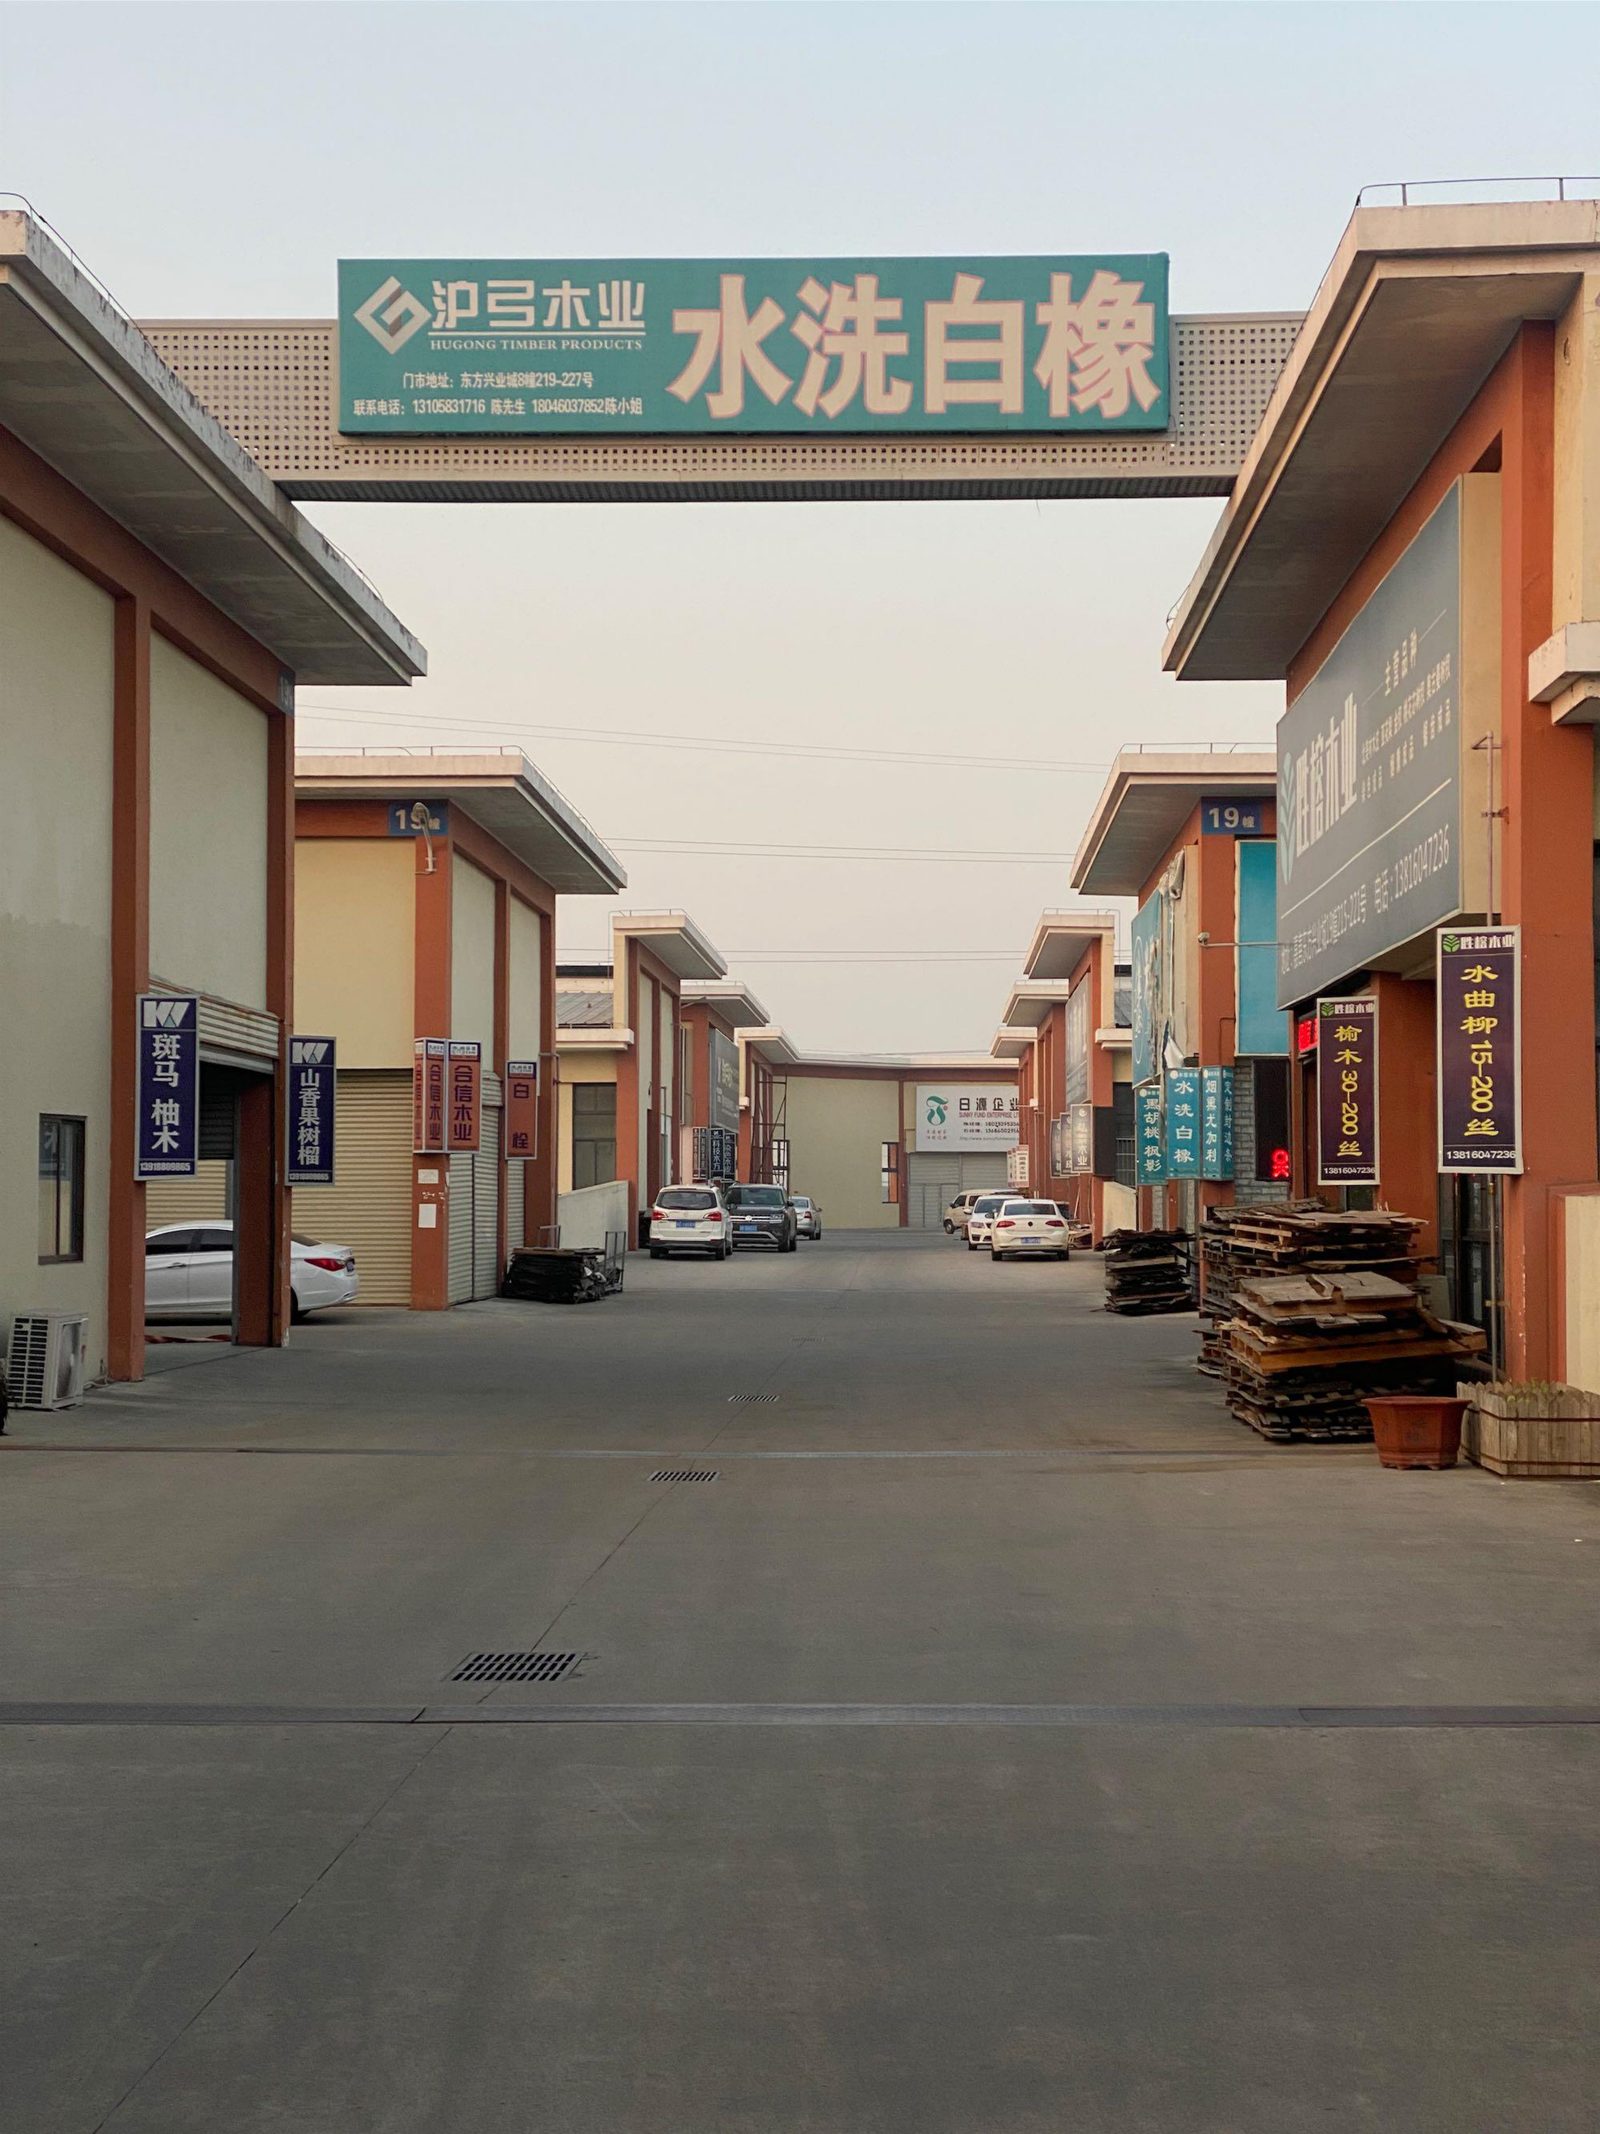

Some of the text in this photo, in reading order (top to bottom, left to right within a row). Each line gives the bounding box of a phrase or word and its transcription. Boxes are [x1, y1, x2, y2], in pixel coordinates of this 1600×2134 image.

[432, 280, 645, 329] 沪弓木业
[430, 339, 642, 350] HUGONG TIMBER PRODUCTS
[664, 270, 1162, 420] 水洗白橡
[413, 398, 486, 415] 13105831716
[297, 1068, 321, 1166] 山香果树榴
[453, 1065, 473, 1141] 合信木业
[1174, 1080, 1195, 1163] 水洗白橡
[1324, 1167, 1375, 1175] 13816047236
[1446, 1150, 1515, 1160] 13816047236
